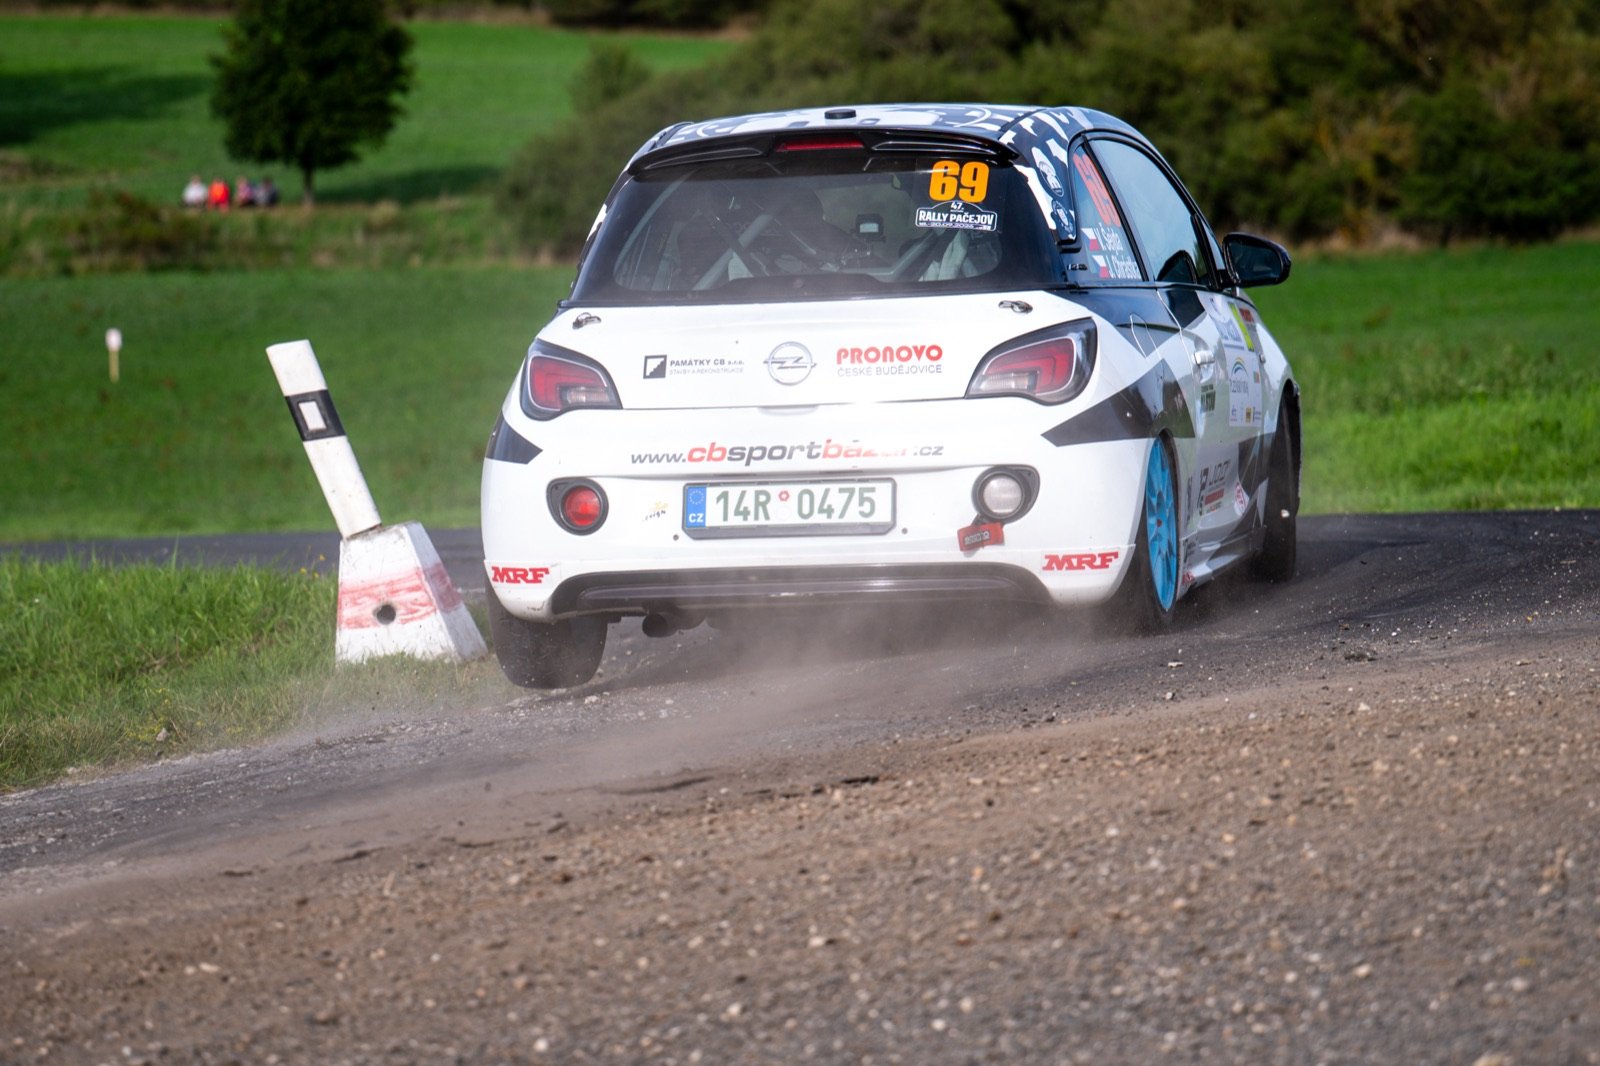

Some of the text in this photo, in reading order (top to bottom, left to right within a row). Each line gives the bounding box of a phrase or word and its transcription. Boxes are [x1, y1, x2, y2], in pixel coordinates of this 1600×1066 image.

[929, 160, 990, 203] 69
[918, 210, 995, 225] RALLY PAČEJOV
[670, 358, 711, 367] PAMÁTKY
[713, 358, 726, 366] CB
[836, 344, 943, 365] PRONOVO
[837, 364, 943, 377] ČESKÉ BUDĚJOVICE
[631, 439, 944, 466] www.cbsportba.cz
[715, 487, 876, 522] 14R 0475
[689, 513, 704, 523] CZ
[1042, 552, 1119, 571] MRF
[491, 566, 550, 584] MRF
